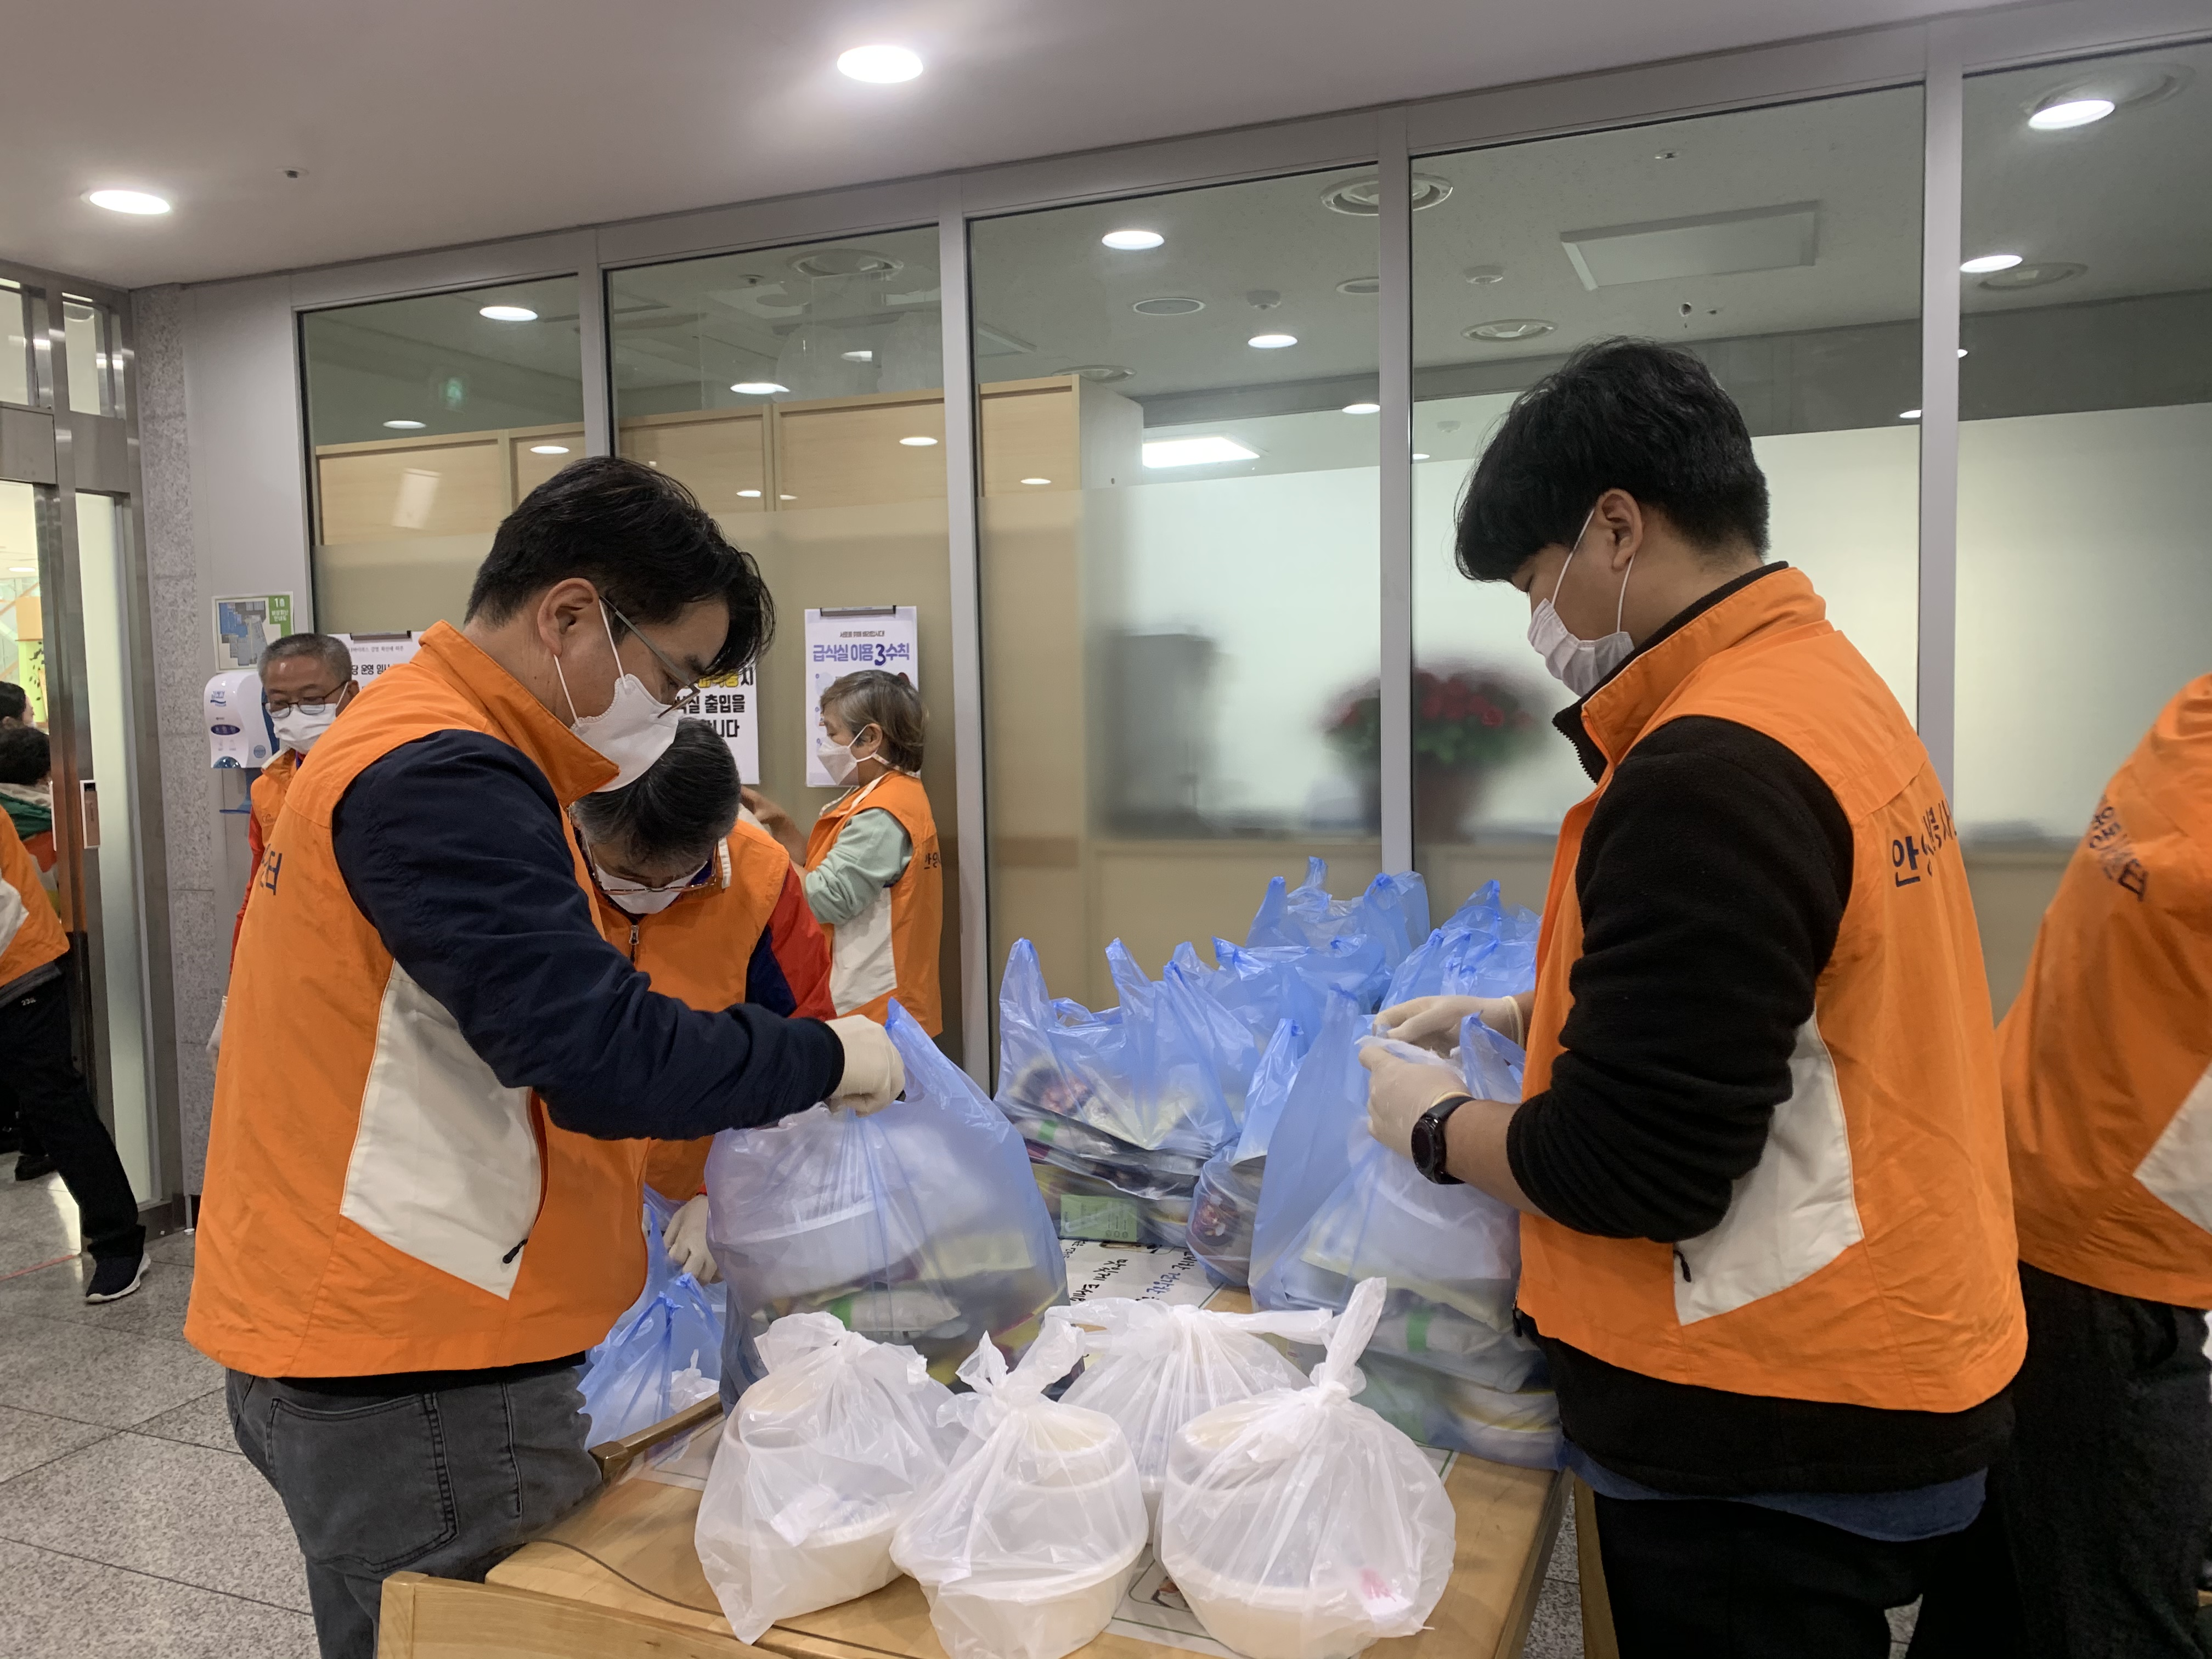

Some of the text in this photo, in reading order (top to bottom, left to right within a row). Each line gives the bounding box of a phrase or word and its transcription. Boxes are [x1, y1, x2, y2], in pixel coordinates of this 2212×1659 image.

[812, 644, 849, 662] 급식실
[851, 643, 874, 662] 이용
[361, 664, 374, 675] 운영
[704, 694, 745, 714] 출입을
